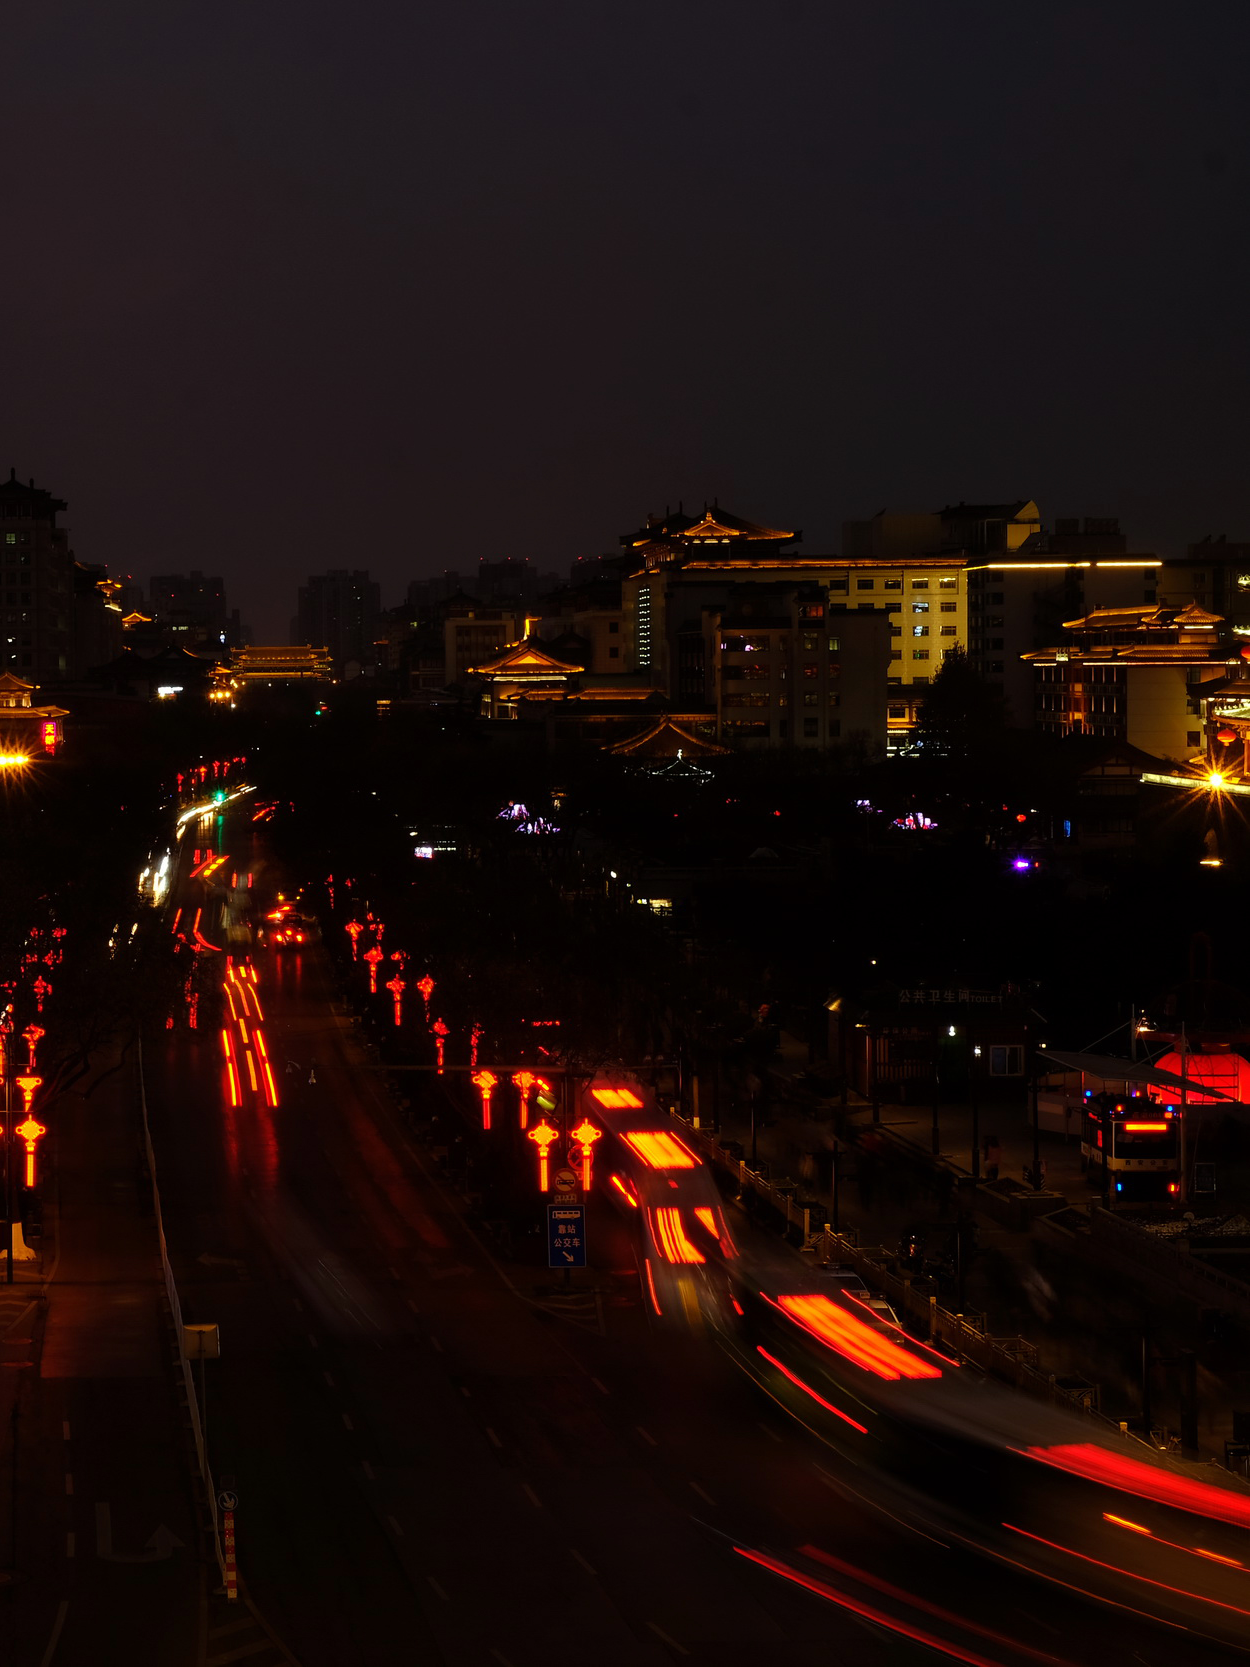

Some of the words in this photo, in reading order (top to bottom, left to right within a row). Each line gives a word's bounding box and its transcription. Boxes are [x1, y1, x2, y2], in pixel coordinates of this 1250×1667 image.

[899, 989, 970, 1003] 公共卫生间
[971, 995, 1003, 1003] TOILET
[558, 1225, 576, 1234] 靠站
[554, 1239, 580, 1247] 公交车
